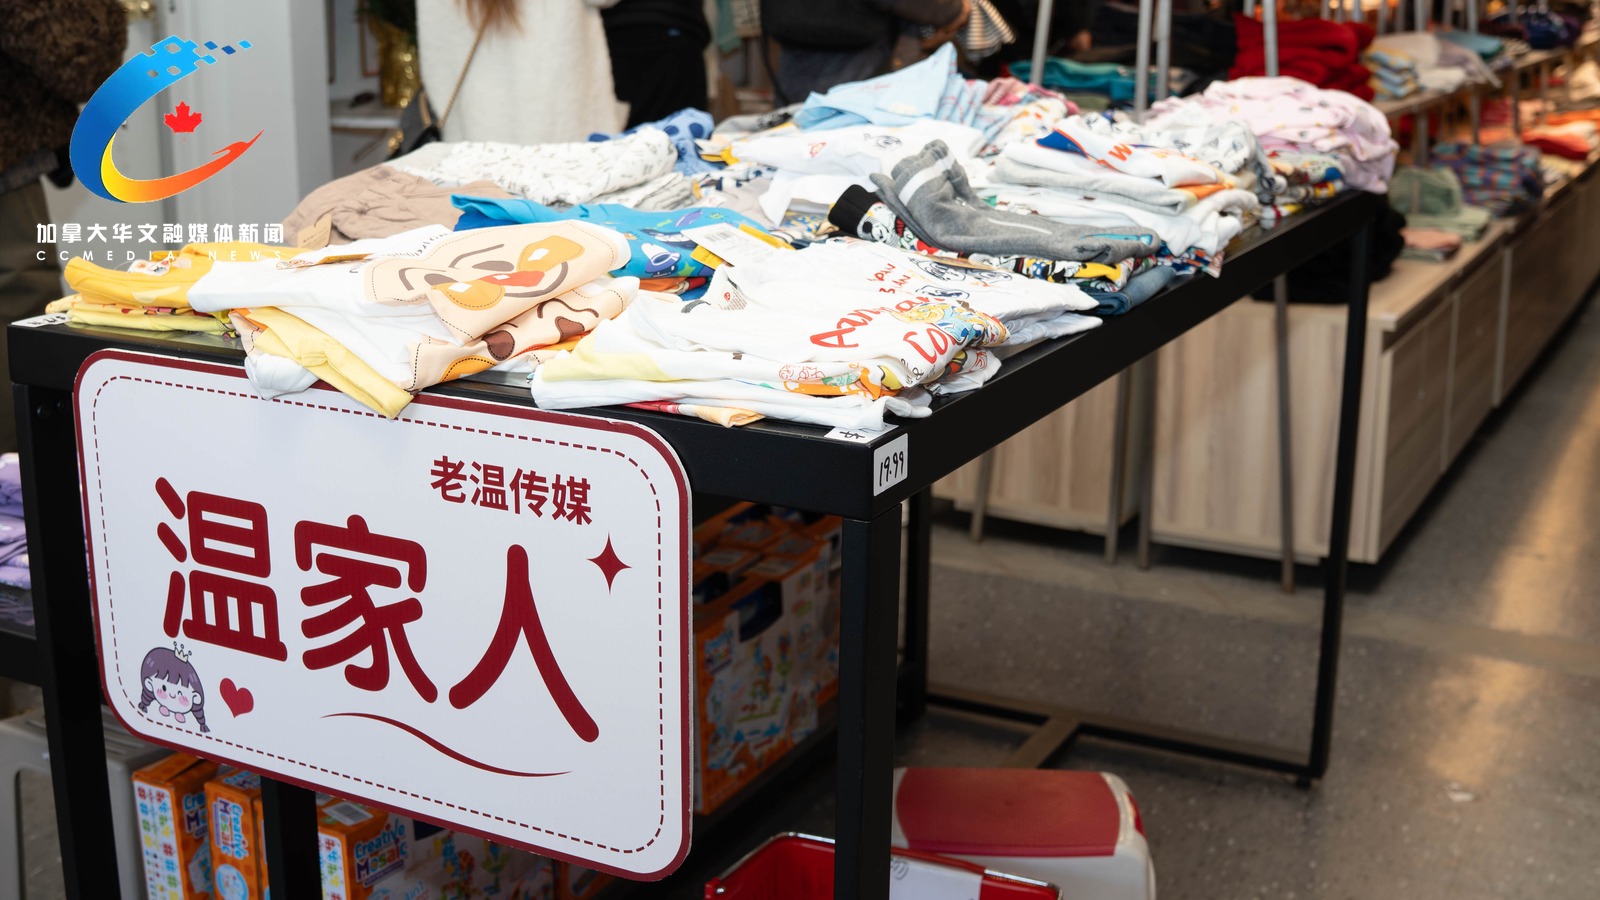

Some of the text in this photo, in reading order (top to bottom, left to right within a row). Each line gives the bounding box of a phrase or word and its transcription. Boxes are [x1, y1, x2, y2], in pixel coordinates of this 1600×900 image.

[879, 451, 904, 487] 19.99
[430, 456, 592, 525] 老温传媒
[155, 477, 600, 743] 温家人
[355, 818, 405, 858] Creative
[357, 841, 407, 880] Mosaic
